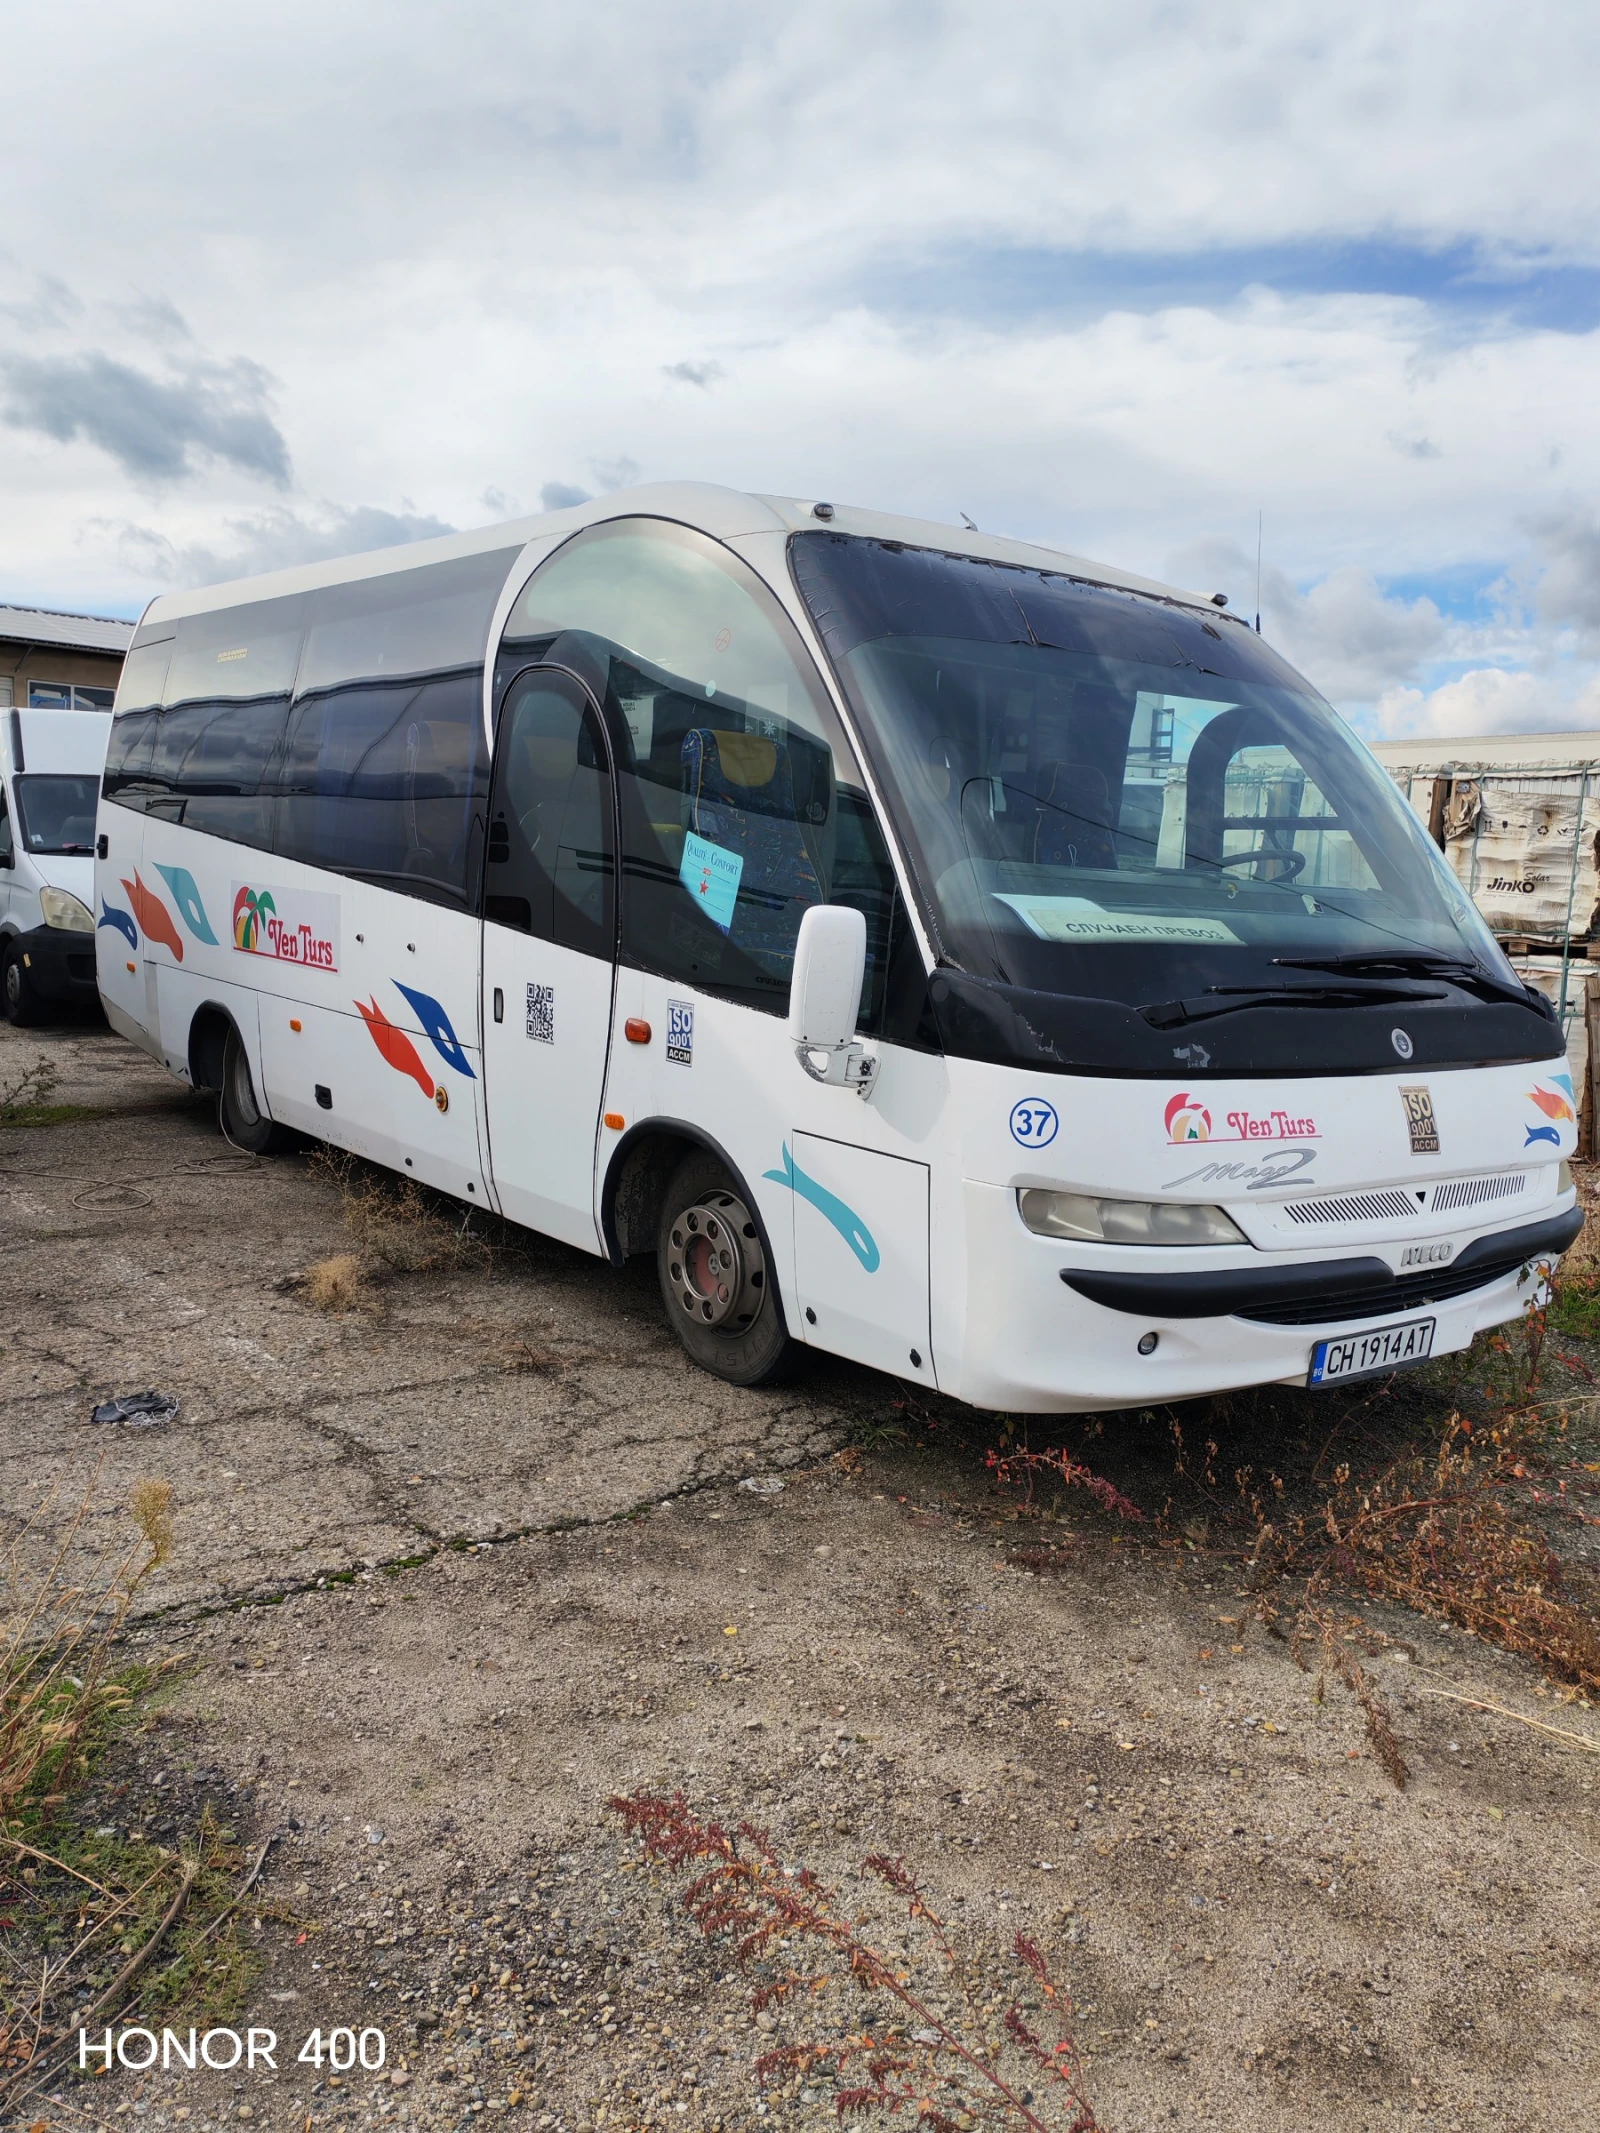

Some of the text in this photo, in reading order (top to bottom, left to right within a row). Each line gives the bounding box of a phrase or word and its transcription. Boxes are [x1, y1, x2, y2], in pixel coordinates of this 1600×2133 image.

[268, 918, 333, 965] Ven Turs
[1066, 923, 1224, 940] СЛУЧАЕН ПРЕВОЗ
[668, 1007, 692, 1033] ISO
[669, 1033, 692, 1048] 9001
[668, 1048, 690, 1062] ACCM
[1402, 1092, 1432, 1122] ISO
[1016, 1109, 1051, 1137] 37
[1227, 1111, 1316, 1139] Ven Turs
[1411, 1116, 1437, 1137] 9001
[1413, 1139, 1438, 1151] ACCM
[1401, 1241, 1453, 1267] IVECO
[1313, 1367, 1322, 1377] BG
